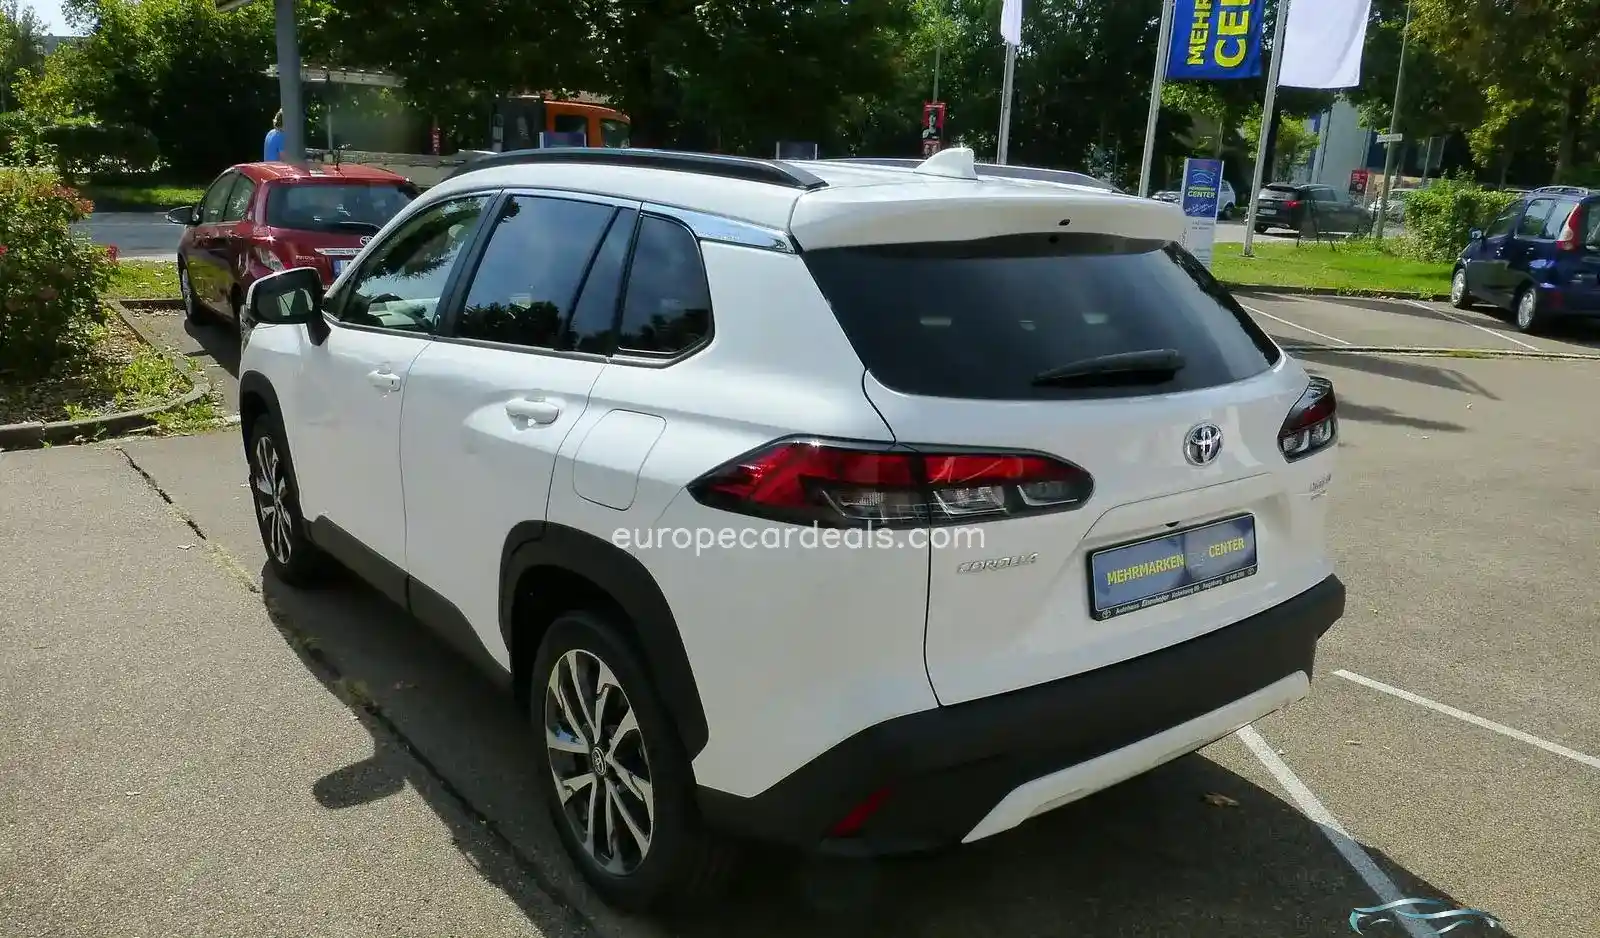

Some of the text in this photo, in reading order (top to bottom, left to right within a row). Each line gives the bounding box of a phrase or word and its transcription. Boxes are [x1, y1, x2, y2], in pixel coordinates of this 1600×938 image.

[1214, 0, 1251, 68] CE
[1107, 537, 1245, 586] MEHRMARKEN CENTER
